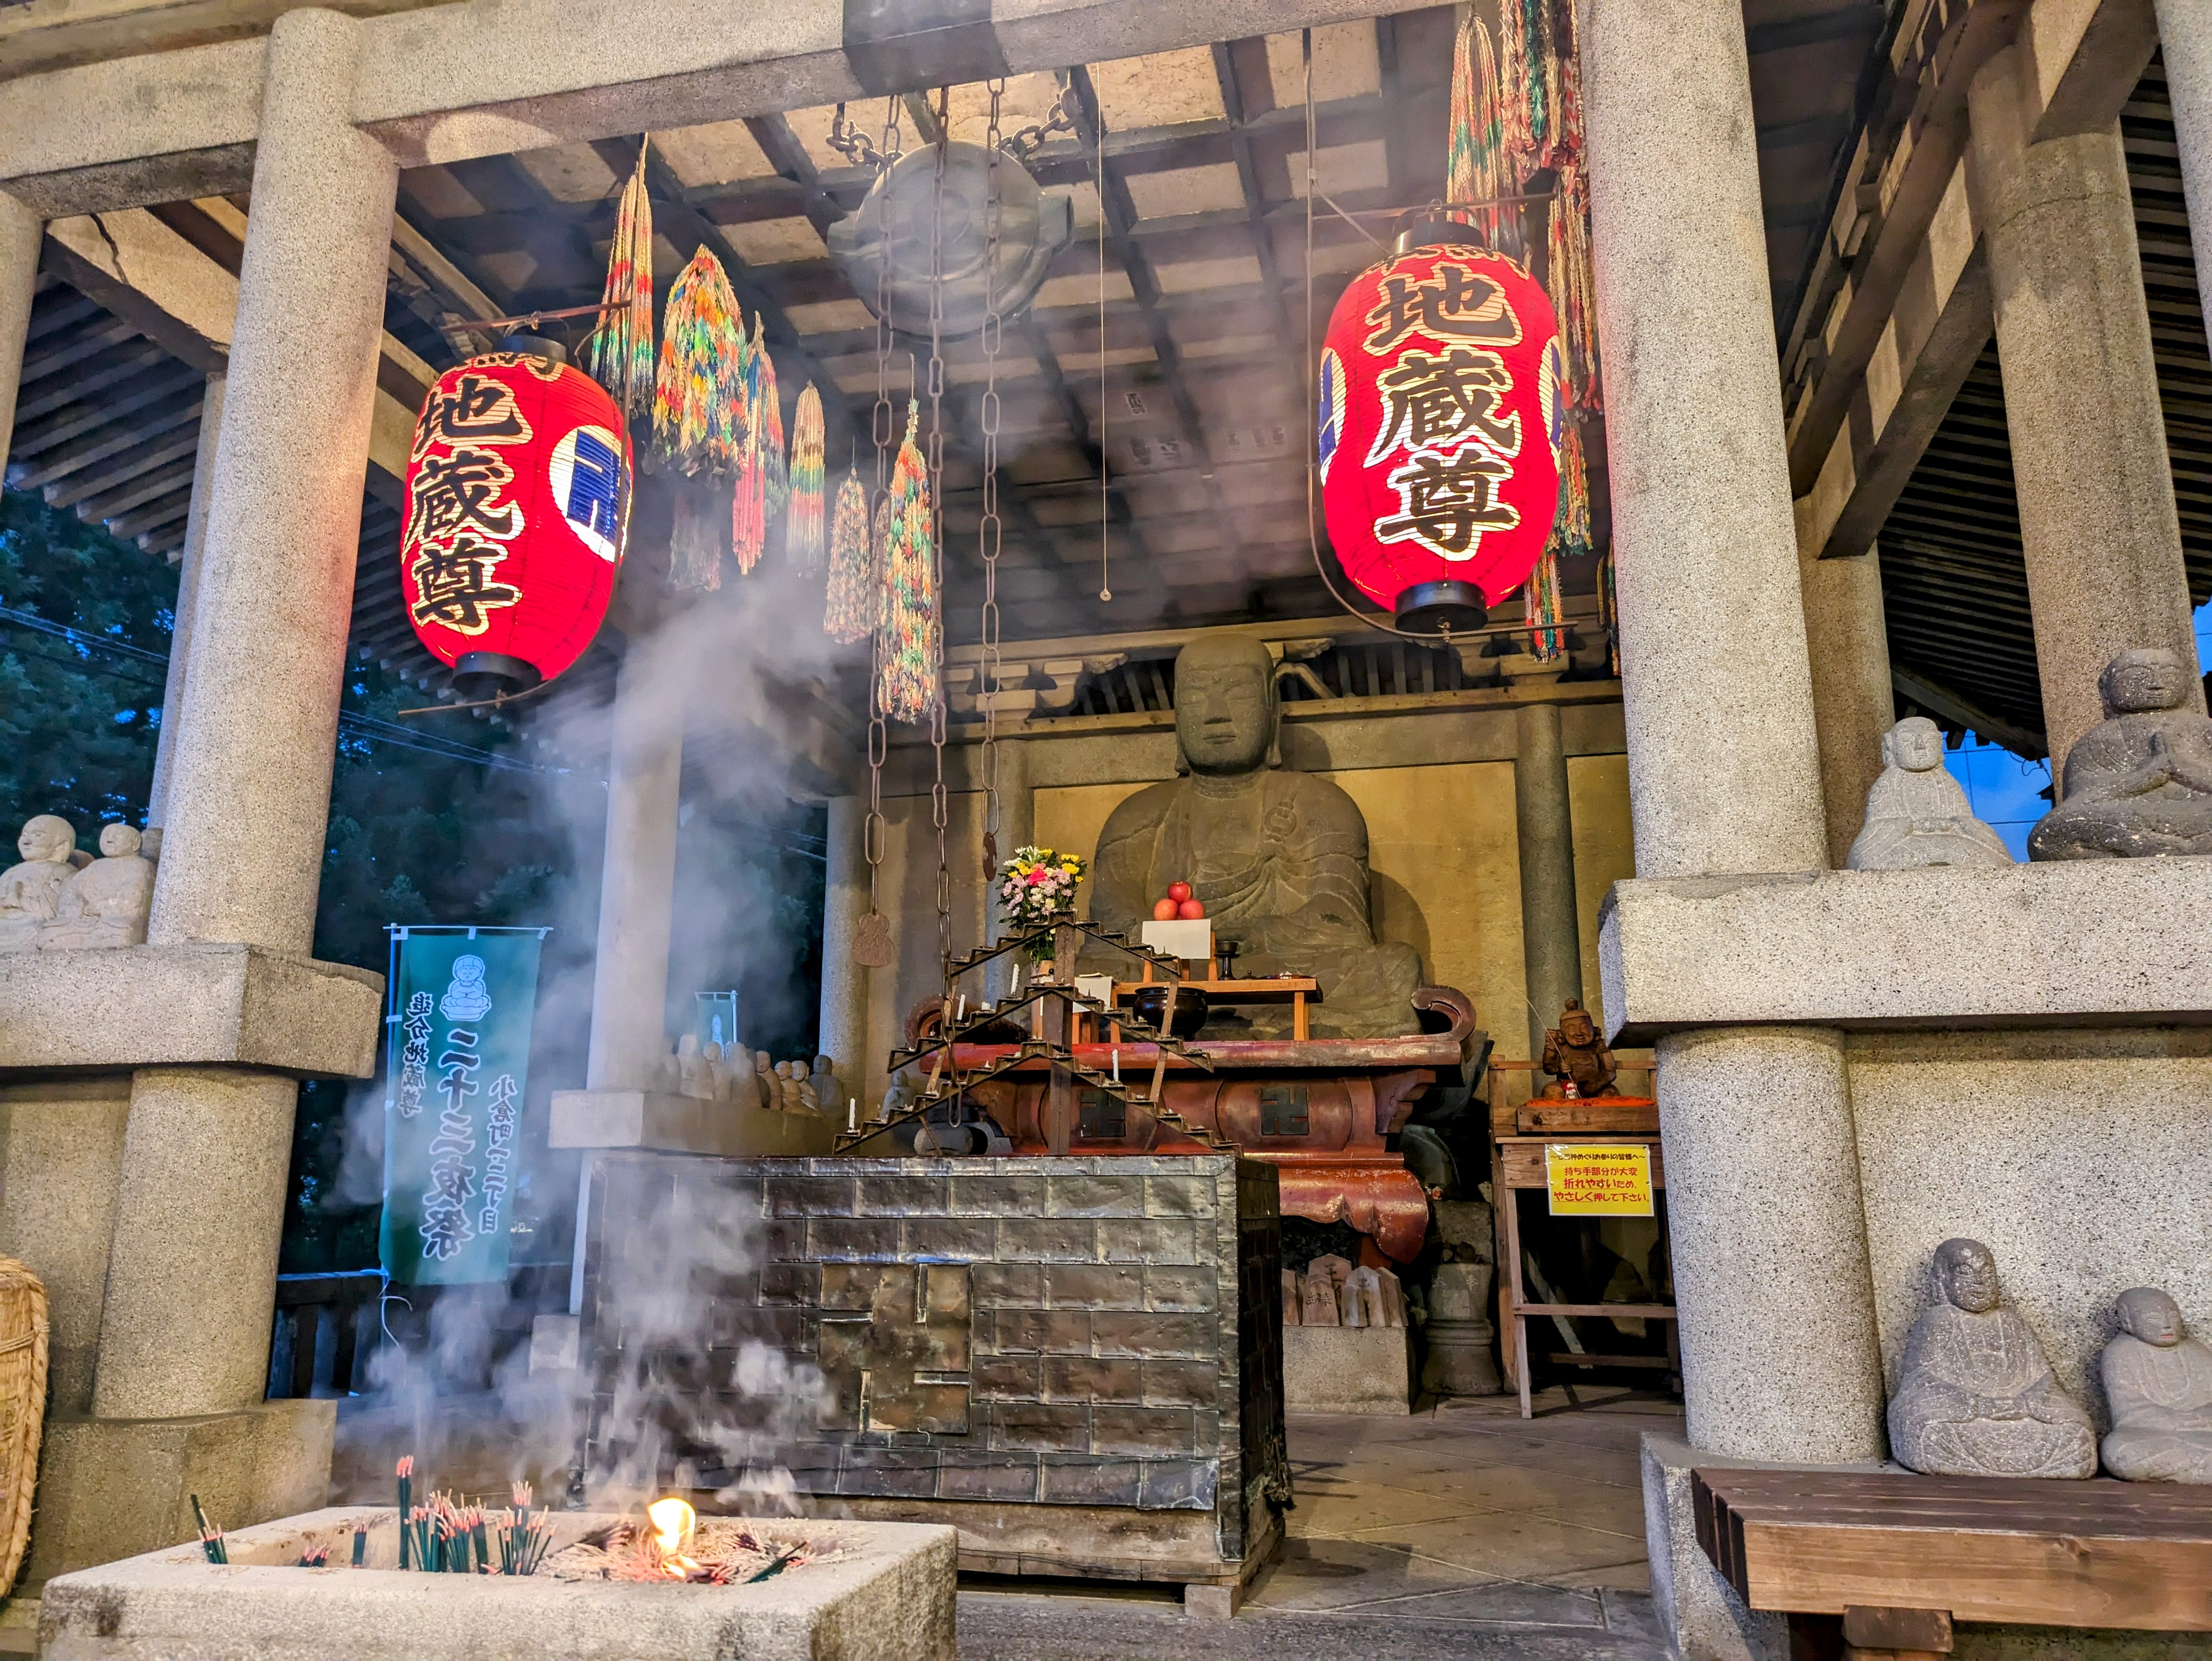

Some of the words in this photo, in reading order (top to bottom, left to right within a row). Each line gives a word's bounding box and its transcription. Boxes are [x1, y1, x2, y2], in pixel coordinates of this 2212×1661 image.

[1363, 262, 1522, 561] 地蔵尊
[402, 375, 533, 635] 地蔵尊
[1564, 1167, 1638, 1176] 持ち手部分が大変
[1563, 1178, 1637, 1189] 折れやすいため、
[1554, 1192, 1650, 1203] やさしく押して下さい。
